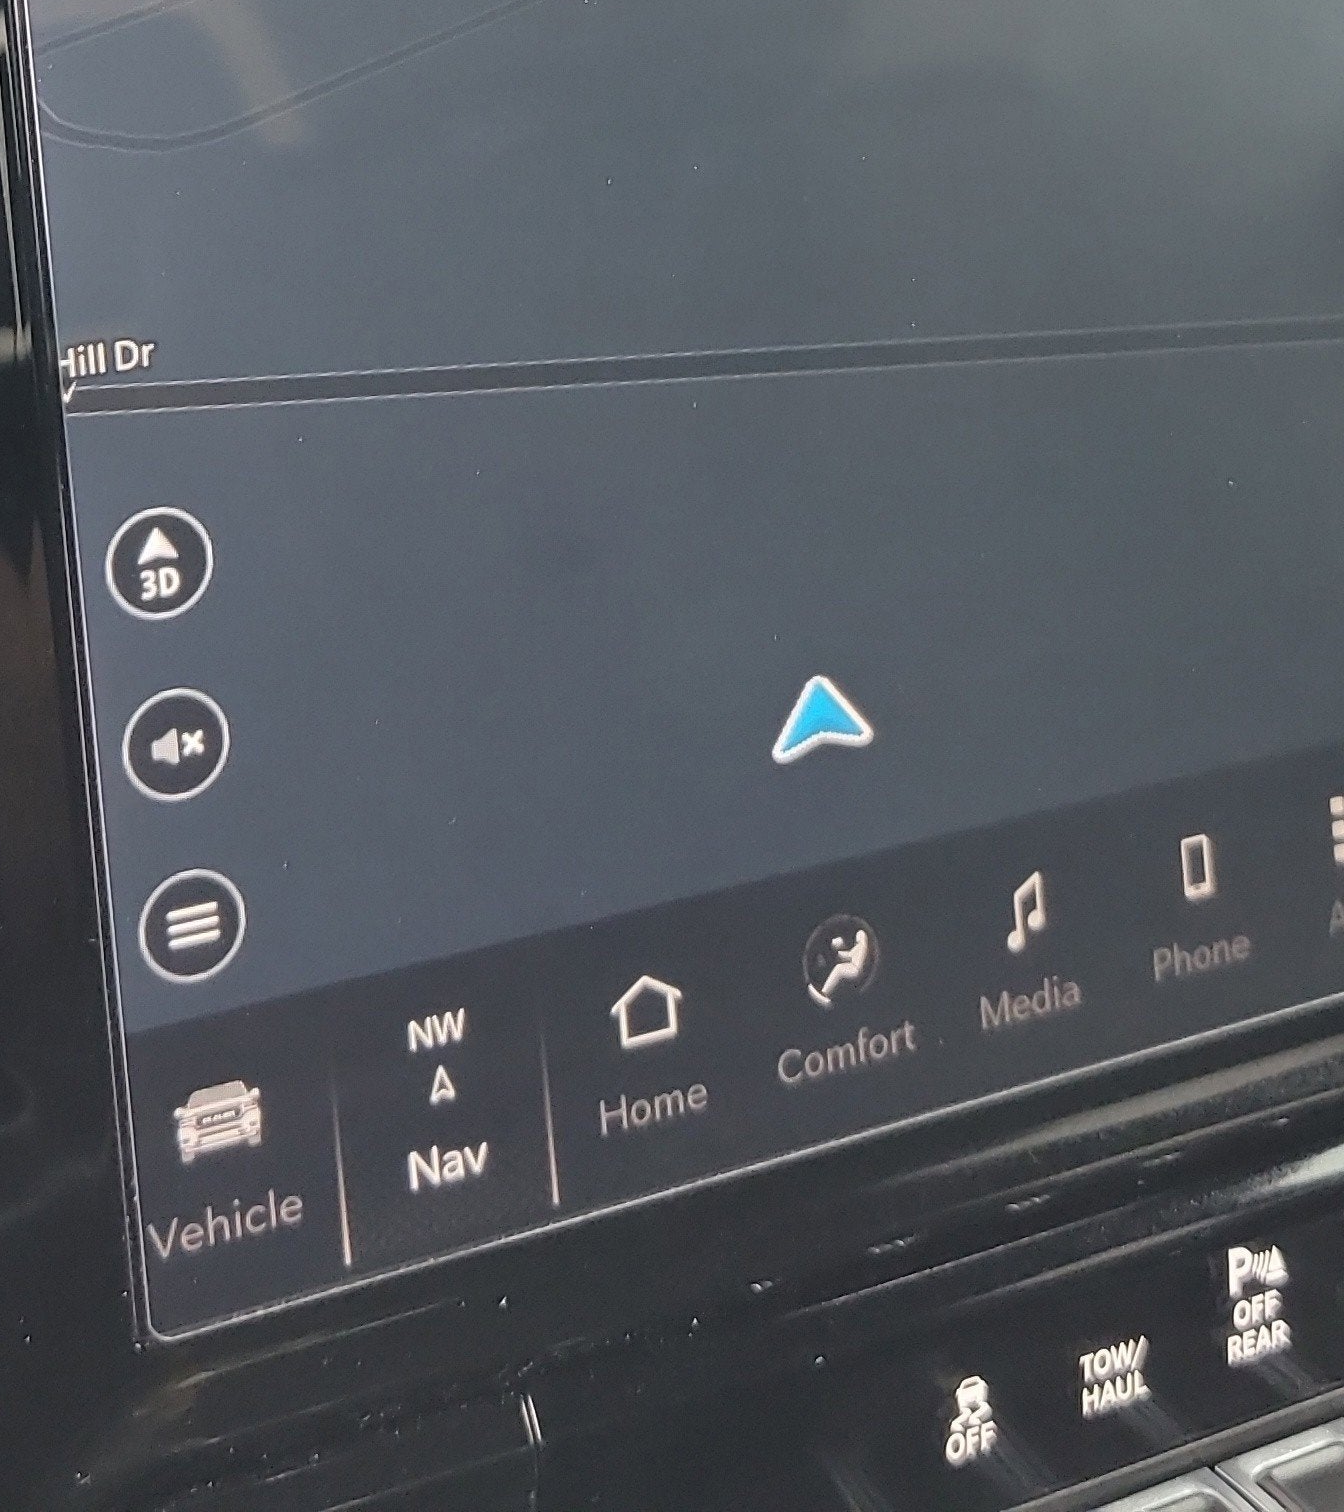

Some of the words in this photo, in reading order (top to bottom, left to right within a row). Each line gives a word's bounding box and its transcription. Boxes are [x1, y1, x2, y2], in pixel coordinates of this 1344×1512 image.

[114, 339, 155, 373] Dr
[139, 567, 181, 602] 3D
[1152, 934, 1251, 983] Phone
[978, 976, 1082, 1033] Media
[407, 1009, 466, 1054] NW
[777, 1020, 918, 1085] Comfort
[598, 1082, 709, 1136] Home
[407, 1138, 488, 1194] Nav
[148, 1190, 304, 1262] Vehicle
[1232, 1288, 1280, 1328] OFF
[1079, 1335, 1148, 1381] TOW/
[1227, 1320, 1290, 1364] REAR
[1081, 1370, 1150, 1418] HAUL
[945, 1422, 996, 1466] OFF
